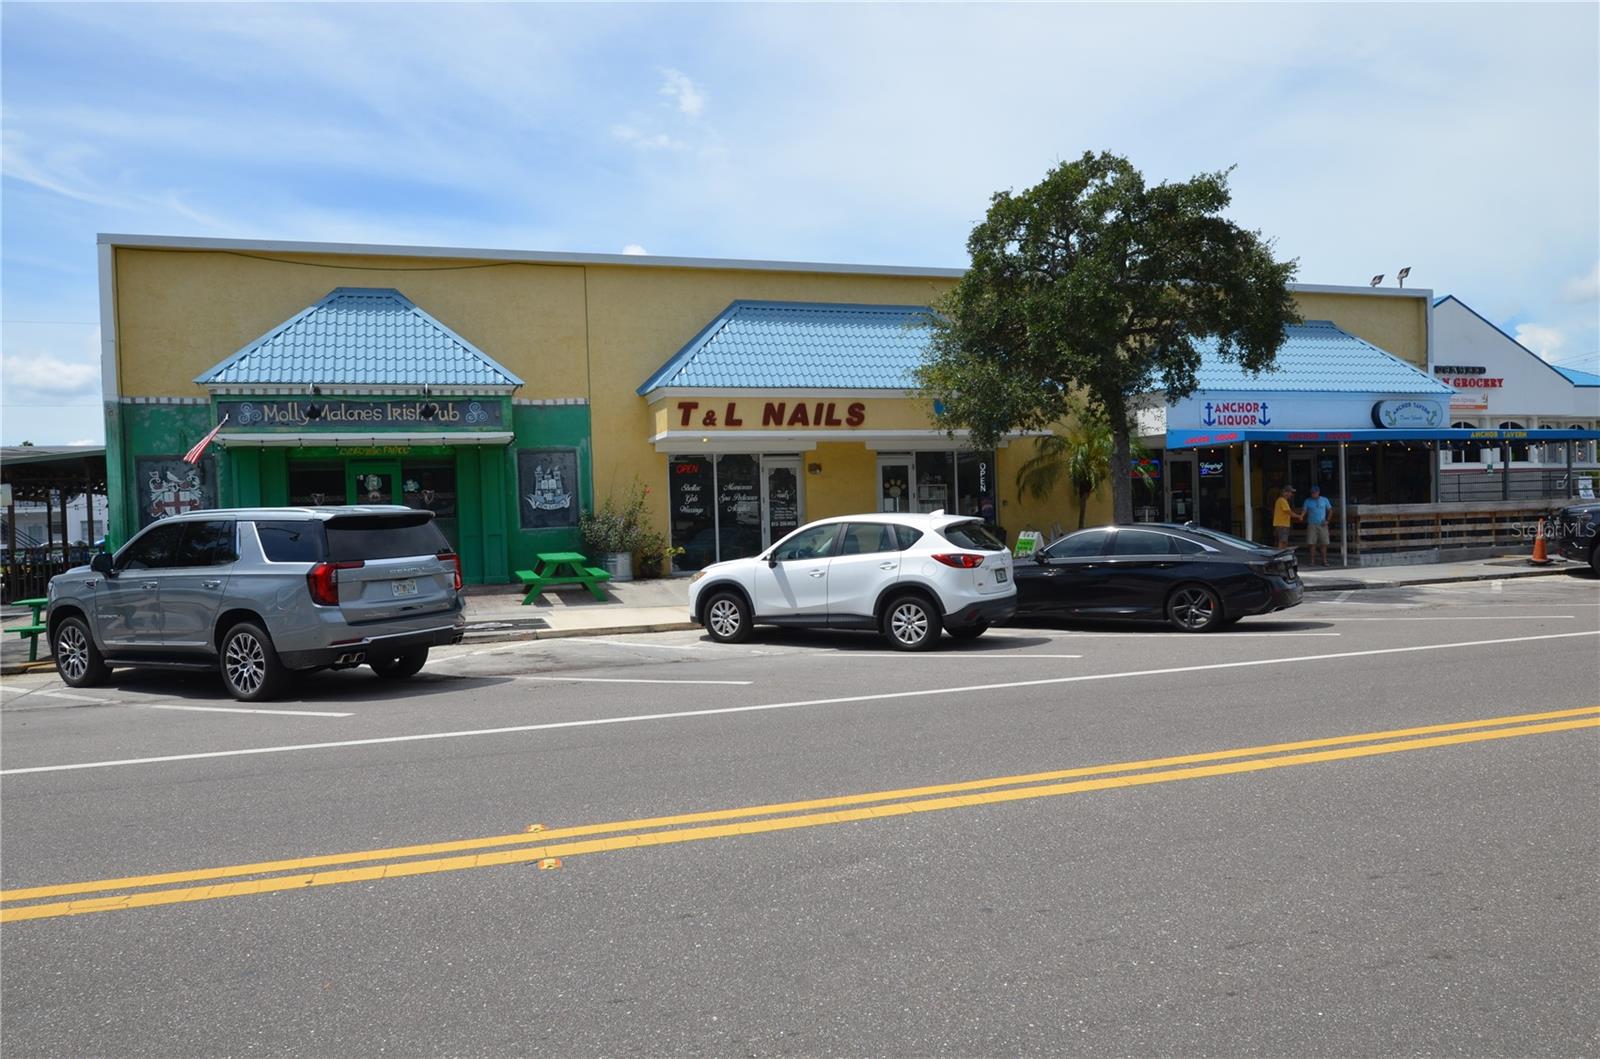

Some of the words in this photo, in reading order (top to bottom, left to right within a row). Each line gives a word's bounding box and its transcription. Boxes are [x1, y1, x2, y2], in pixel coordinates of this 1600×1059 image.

[1454, 378, 1504, 388] GROCERY
[1215, 402, 1259, 413] ANCHOR
[263, 402, 310, 426] Molly
[677, 402, 699, 426] T
[702, 409, 717, 426] &
[724, 402, 743, 426] L
[762, 402, 866, 427] NAILS
[1218, 415, 1256, 425] LIQUOR
[1471, 431, 1498, 439] ANCHOR
[1504, 431, 1528, 439] TAVERN
[677, 464, 700, 474] OPEN
